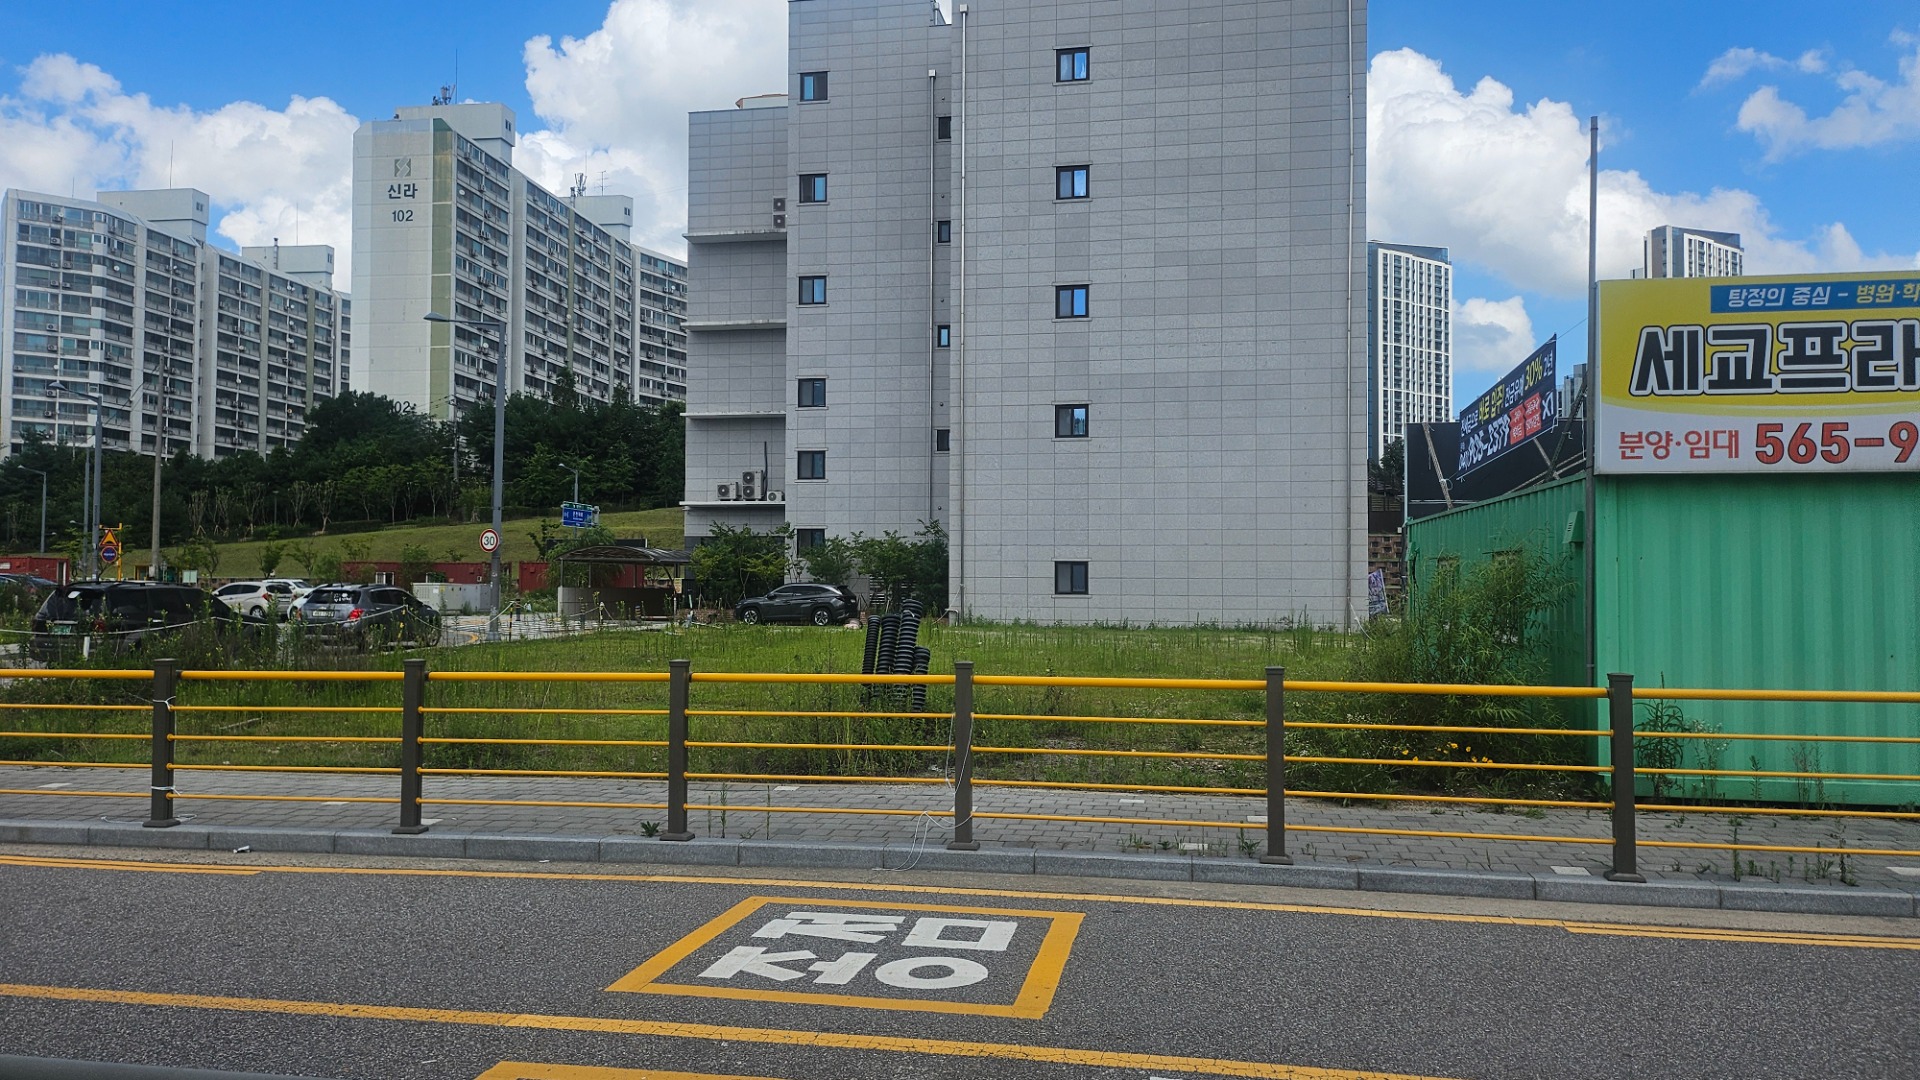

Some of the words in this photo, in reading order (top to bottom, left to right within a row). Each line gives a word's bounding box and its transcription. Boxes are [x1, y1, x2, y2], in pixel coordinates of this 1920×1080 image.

[387, 183, 418, 199] 신라
[392, 209, 414, 222] 102
[1728, 287, 1785, 308] 탕정의
[1792, 286, 1831, 306] 중심
[1524, 354, 1543, 391] 30%
[1618, 430, 1740, 461] 분양·임대
[1755, 421, 1920, 465] 565-9
[483, 535, 495, 546] 30
